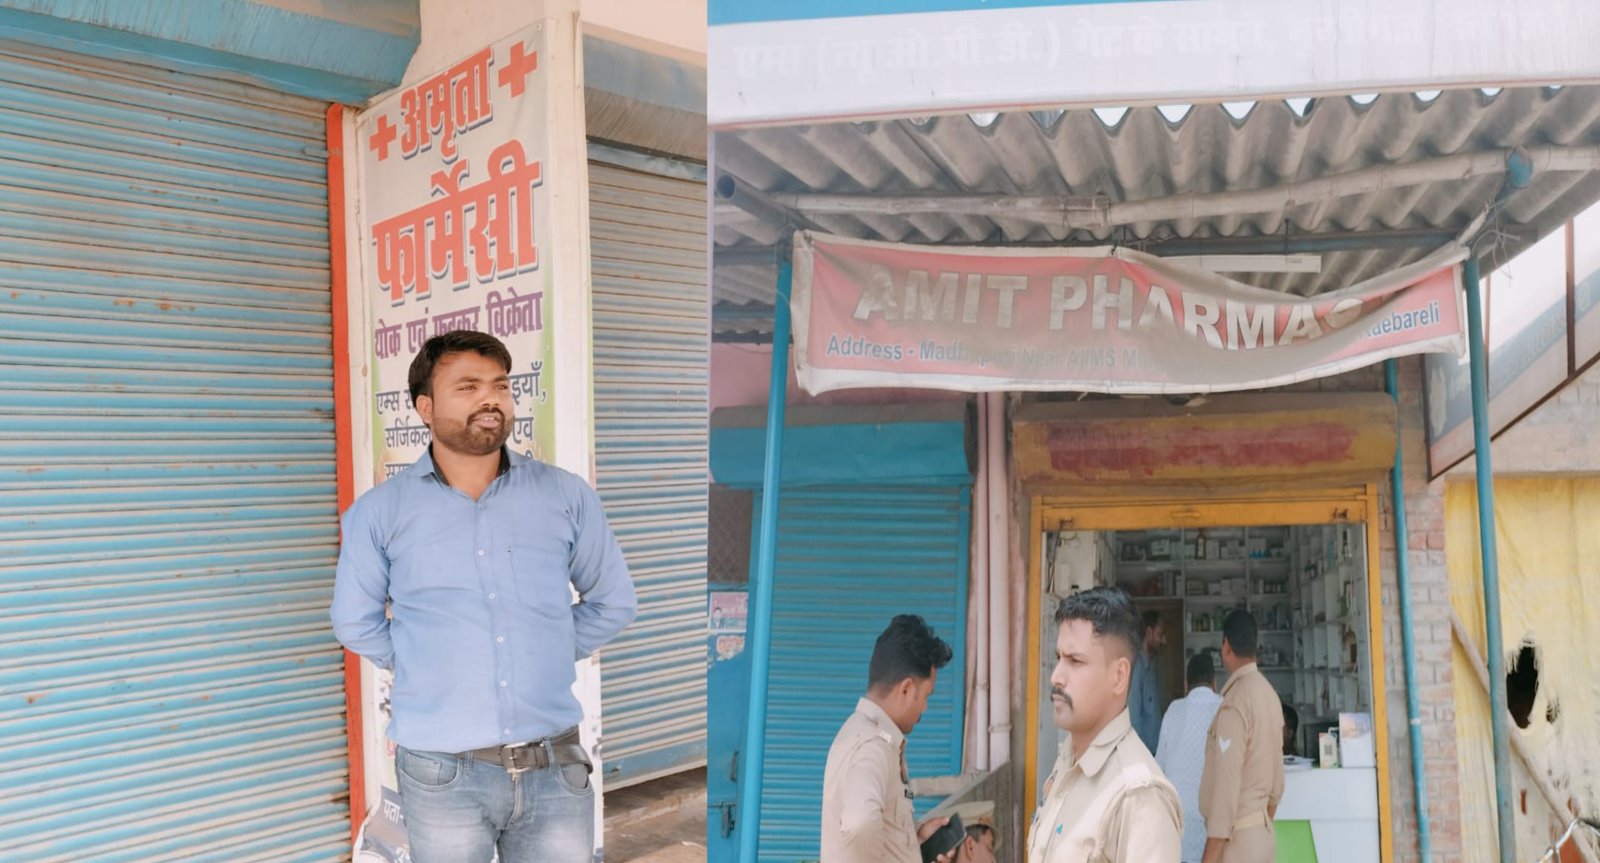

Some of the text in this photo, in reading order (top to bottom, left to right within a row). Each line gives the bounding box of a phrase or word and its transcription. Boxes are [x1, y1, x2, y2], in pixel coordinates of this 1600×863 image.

[400, 45, 494, 166] अमृता
[371, 138, 543, 306] फार्मेसी
[405, 307, 429, 354] एवं
[486, 287, 544, 338] विक्रेता
[853, 265, 1029, 329] AMIT
[827, 334, 902, 361] Address
[1360, 301, 1440, 338] aebareli
[508, 361, 546, 405] इयाँ,
[512, 407, 535, 445] एवं
